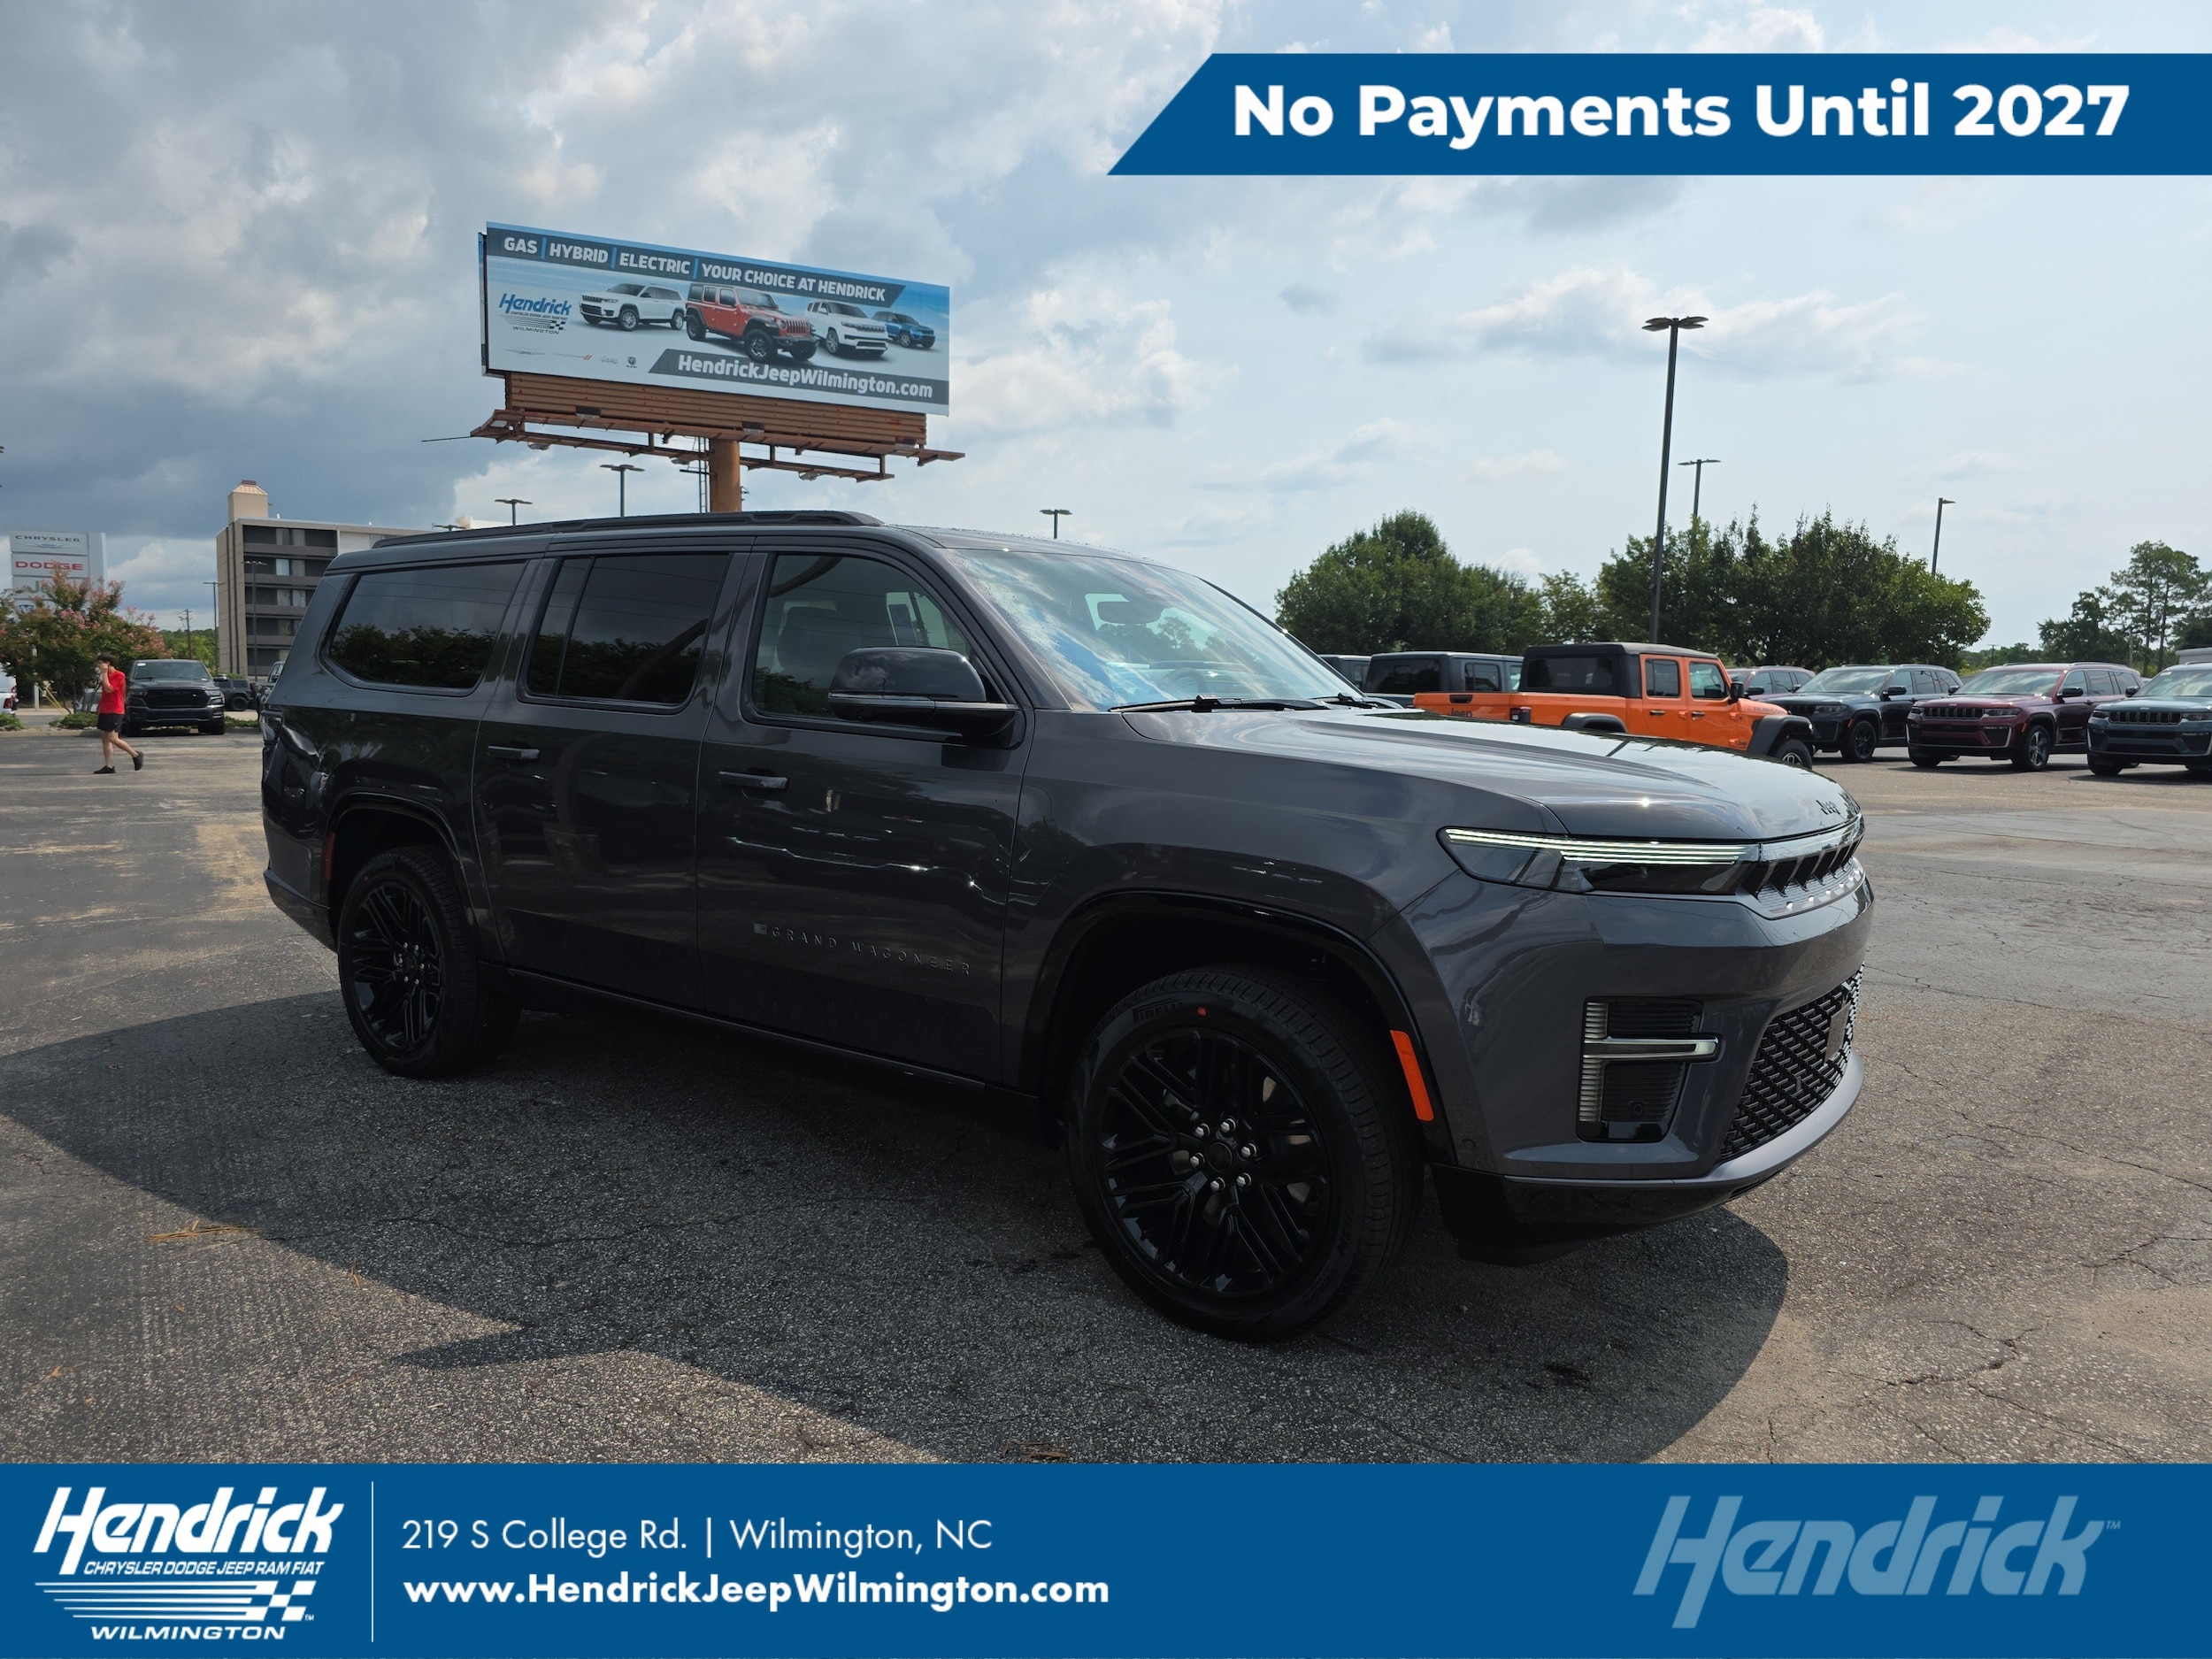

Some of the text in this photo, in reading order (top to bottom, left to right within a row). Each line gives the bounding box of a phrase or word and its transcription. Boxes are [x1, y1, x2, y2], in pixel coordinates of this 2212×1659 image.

[503, 236, 886, 302] GAS HYBRID ELECTRIC YOUR CHOICE AT HENDRICK
[498, 293, 572, 316] Hendrick
[513, 326, 559, 335] WILMINGTON
[678, 354, 933, 398] HendrickJeepWilmington.com
[772, 926, 971, 975] GRAND WAGONEER
